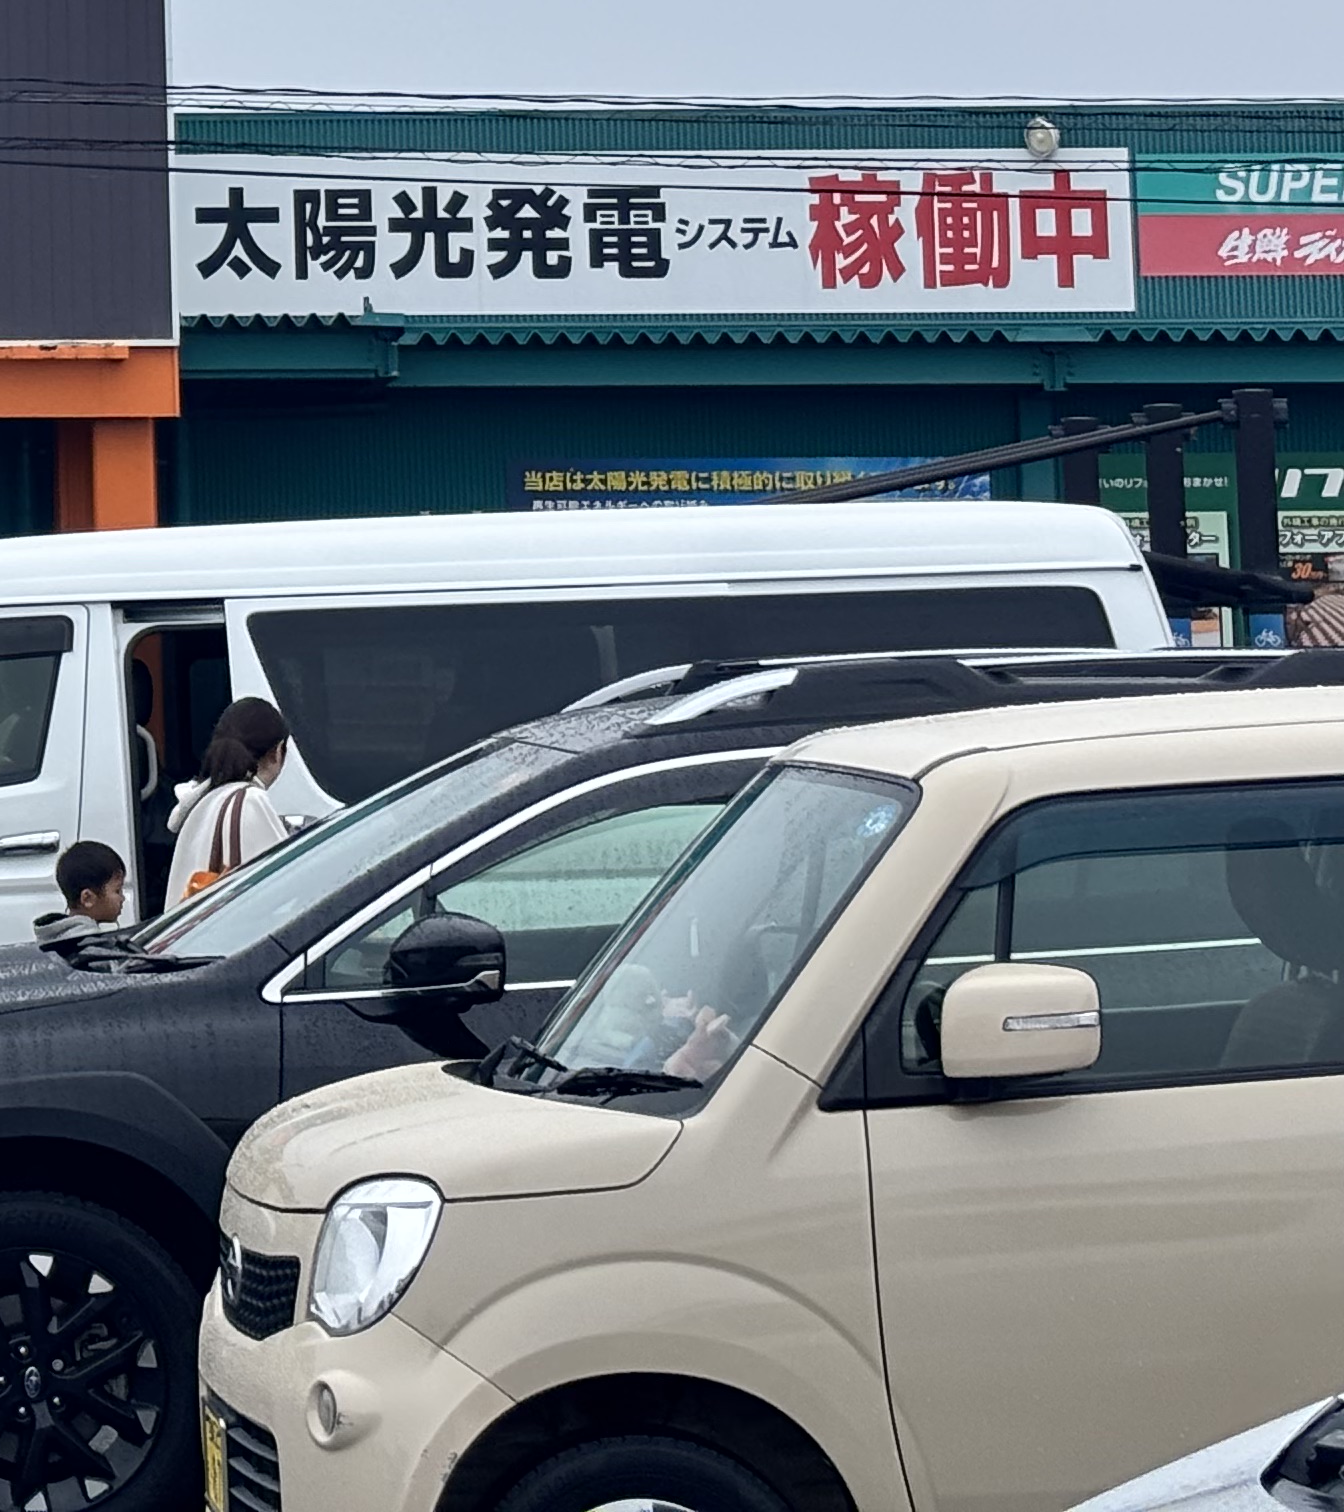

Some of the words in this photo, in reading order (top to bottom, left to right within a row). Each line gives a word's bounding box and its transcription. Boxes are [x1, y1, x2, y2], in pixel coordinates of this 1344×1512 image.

[1215, 162, 1344, 203] SUPE
[195, 169, 1110, 289] 太陽光発電システム稼働中
